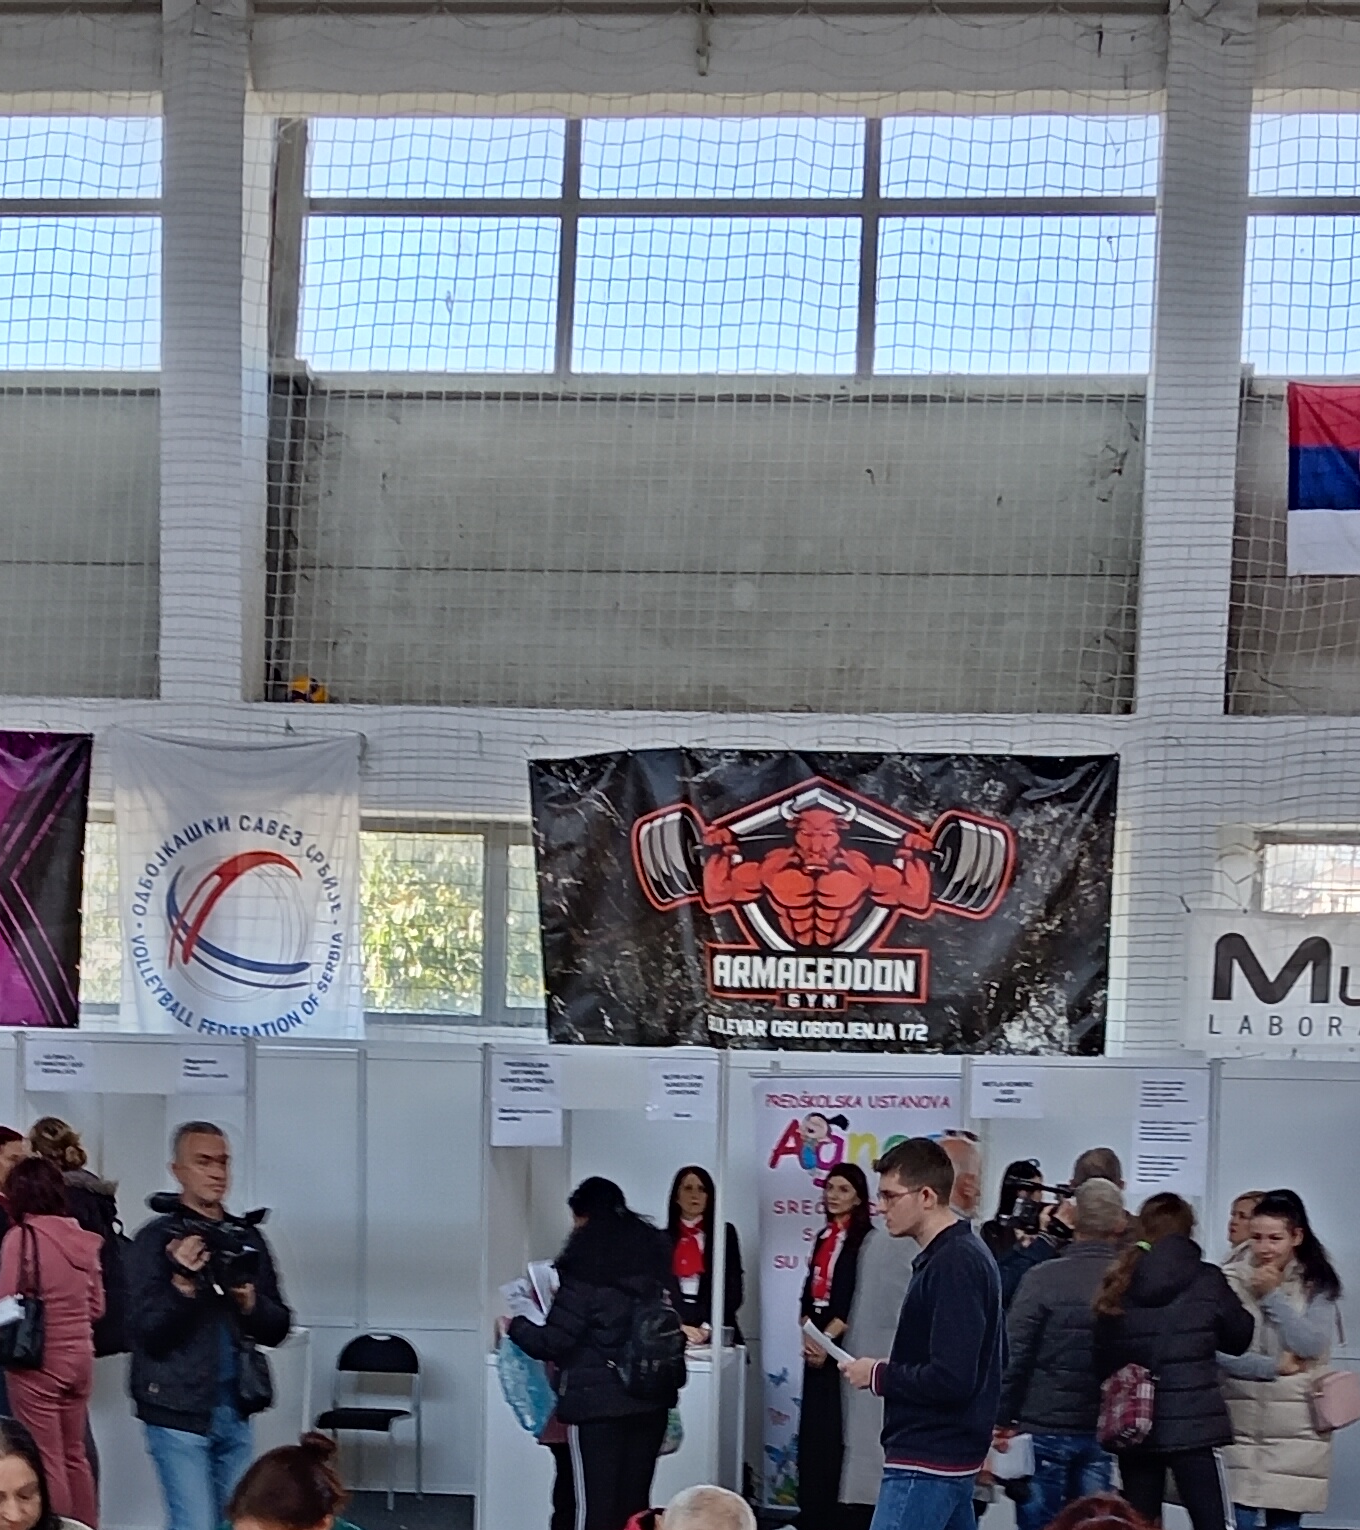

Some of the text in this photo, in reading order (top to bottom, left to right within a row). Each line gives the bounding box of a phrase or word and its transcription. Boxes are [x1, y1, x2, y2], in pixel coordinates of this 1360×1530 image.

[239, 814, 303, 846] САВЕЗ
[305, 843, 342, 914] СРБИЈЕ
[130, 933, 193, 1028] VOLLEYBALL
[300, 993, 320, 1016] OF
[318, 932, 344, 994] SERBIA
[712, 955, 916, 993] ARMAGEDDON
[787, 993, 838, 1009] GYM
[898, 1022, 929, 1042] 172
[867, 1094, 951, 1109] USTANOVA
